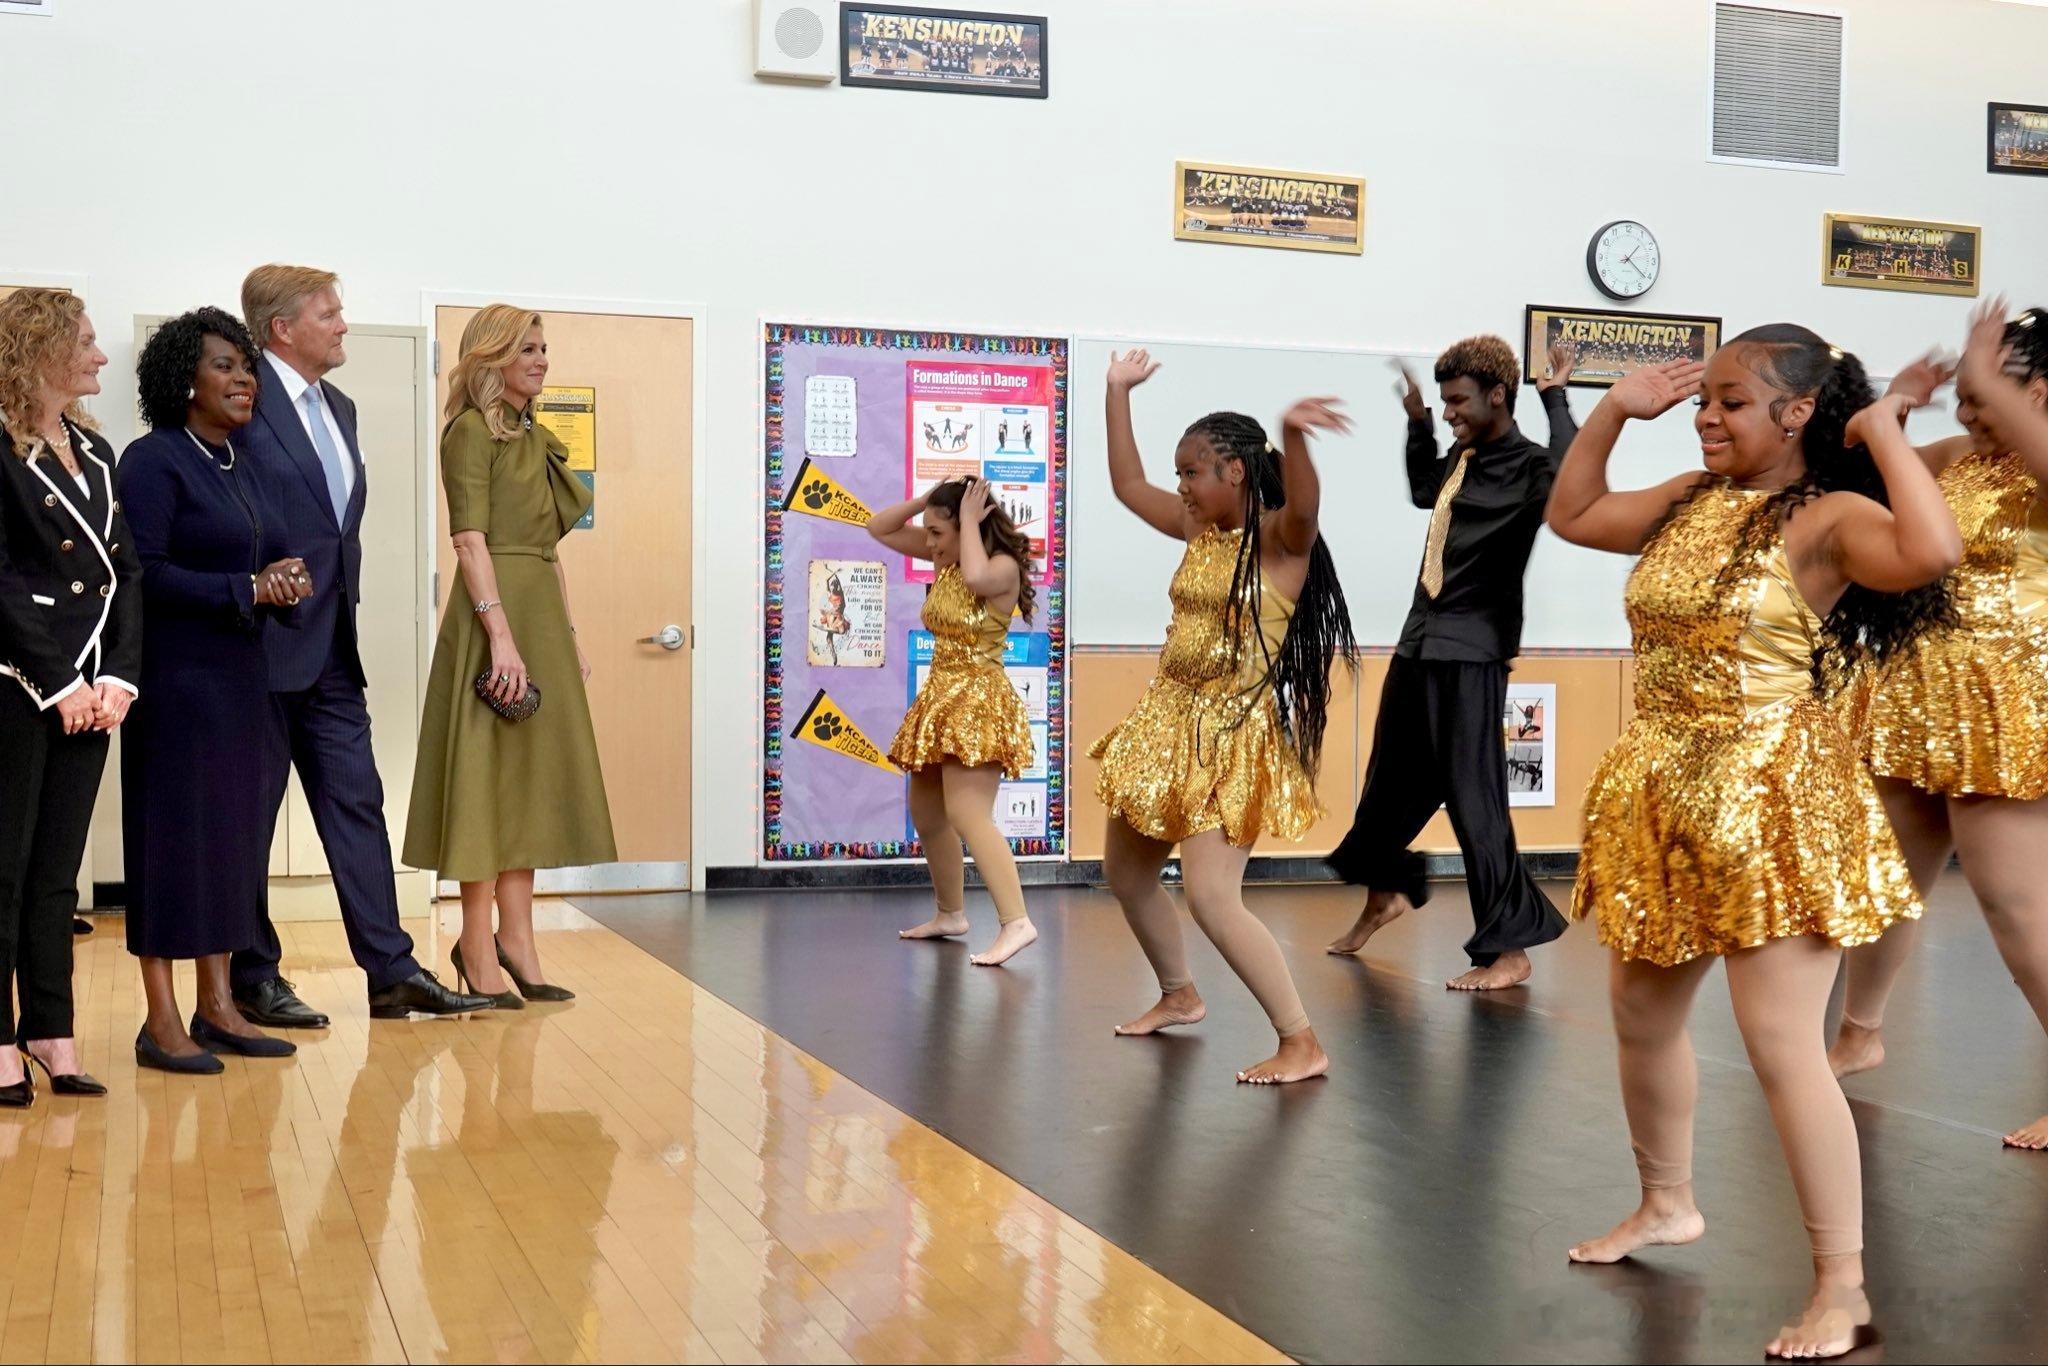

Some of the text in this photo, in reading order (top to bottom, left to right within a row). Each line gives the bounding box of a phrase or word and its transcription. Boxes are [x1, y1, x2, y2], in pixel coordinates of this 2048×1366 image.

[863, 15, 1024, 47] KENSINGTON
[1612, 228, 1617, 236] 11
[1625, 225, 1632, 233] 12
[1603, 238, 1609, 246] 10
[1648, 242, 1653, 250] 2
[1599, 253, 1603, 261] 9
[1651, 257, 1656, 265] 3
[1838, 256, 1966, 276] K H S
[1602, 269, 1606, 277] 8
[1560, 320, 1692, 347] KENSINGTON
[913, 369, 1028, 387] Formations in Dance
[850, 575, 883, 584] ALWAYS
[864, 650, 873, 658] TO
[836, 733, 879, 763] TIGERS
